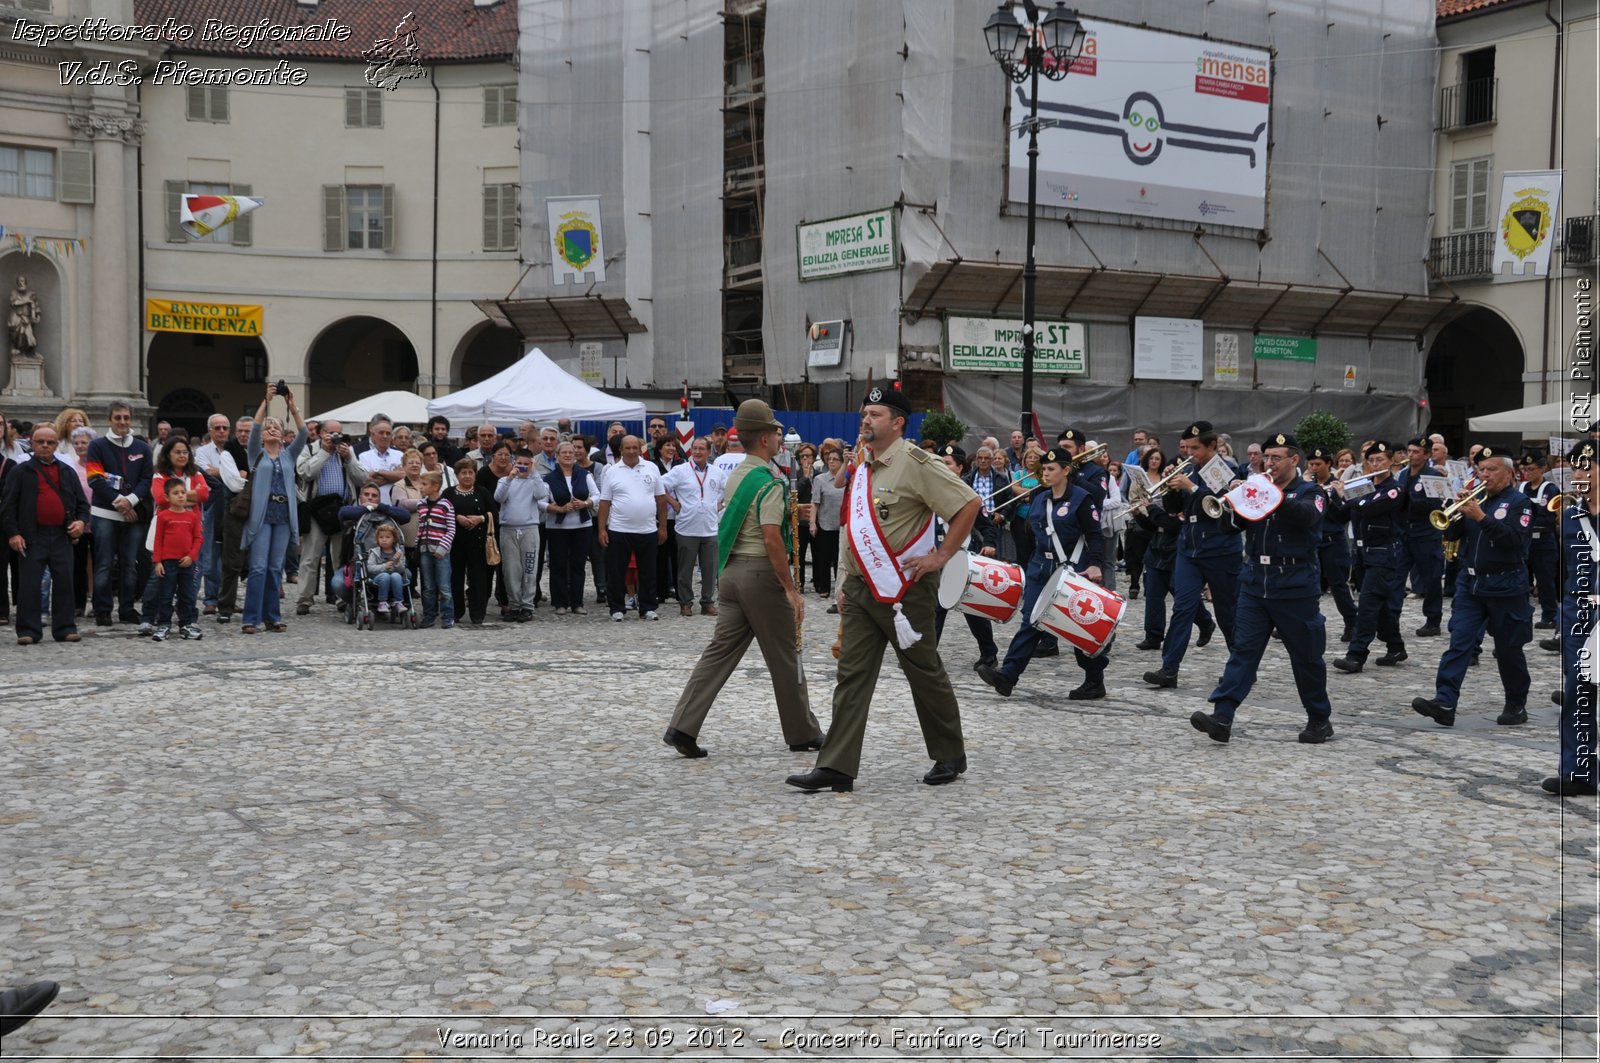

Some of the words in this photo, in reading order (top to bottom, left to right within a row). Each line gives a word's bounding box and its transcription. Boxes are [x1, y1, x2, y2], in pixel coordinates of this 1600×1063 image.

[1202, 58, 1267, 84] mensa
[825, 226, 863, 247] IMPRESA
[867, 216, 885, 240] ST
[803, 252, 839, 266] EDILIZIA
[841, 243, 891, 261] GENERALE
[171, 303, 219, 316] BANCO
[225, 306, 241, 317] DI
[152, 314, 258, 333] BENEFICENZA
[1048, 325, 1070, 345] ST
[1255, 338, 1275, 346] UNITED
[1275, 339, 1299, 348] COLORS
[952, 345, 1008, 358] EDILIZIA
[860, 528, 882, 569] CARITAS
[525, 549, 536, 575] REBEL
